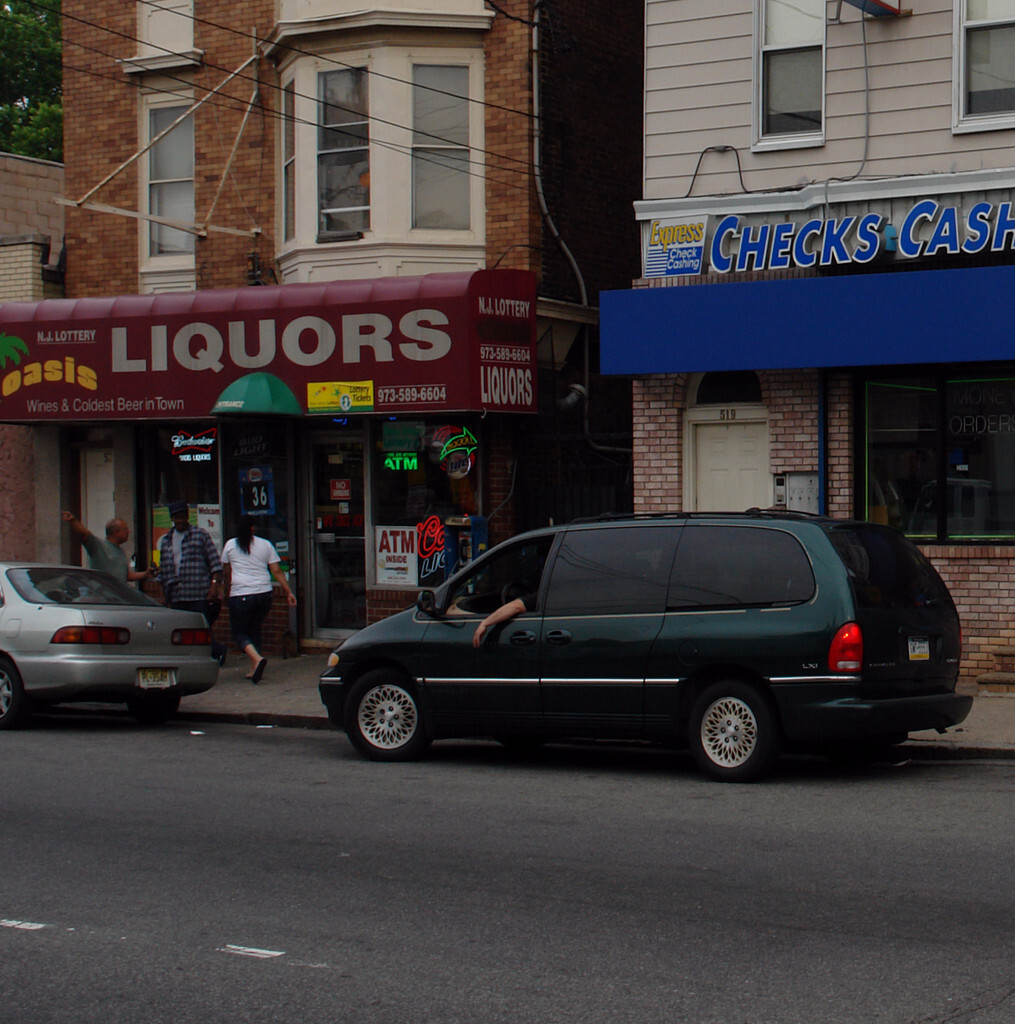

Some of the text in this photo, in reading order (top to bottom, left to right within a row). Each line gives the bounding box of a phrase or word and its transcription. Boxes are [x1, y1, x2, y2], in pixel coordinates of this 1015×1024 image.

[649, 221, 704, 253] Express
[710, 212, 886, 274] CHECKS
[670, 247, 698, 259] Check
[667, 258, 700, 270] Cashing
[478, 296, 531, 318] N.J. LOTTERY
[37, 329, 97, 342] N.J. LOTTERY
[111, 308, 453, 374] LIQUORS
[480, 346, 531, 361] 973-589-6604
[2, 356, 98, 397] oasis
[480, 365, 533, 406] LIQUORS
[378, 386, 447, 403] 973-589-6604
[26, 396, 185, 413] Wines & Coldest Beer in Town
[719, 409, 736, 421] 519
[384, 457, 418, 470] ATM
[335, 481, 347, 489] NO
[252, 485, 268, 507] 36
[379, 529, 415, 554] ATM
[385, 555, 408, 564] INSIDE
